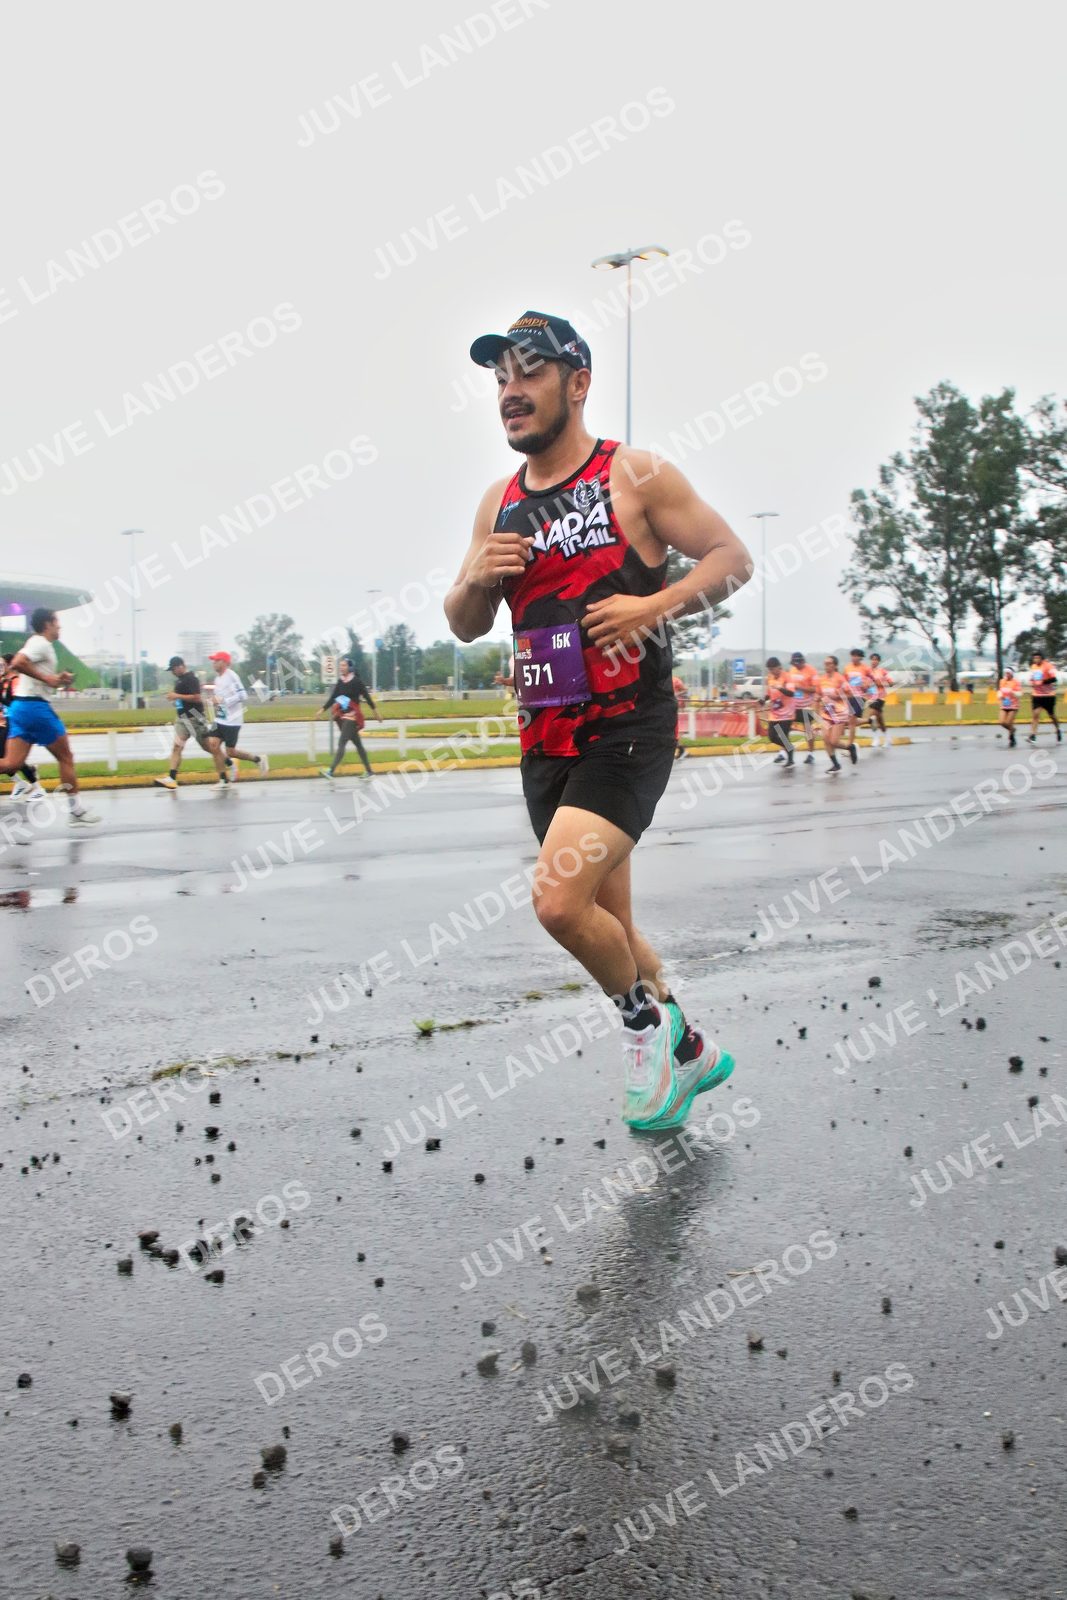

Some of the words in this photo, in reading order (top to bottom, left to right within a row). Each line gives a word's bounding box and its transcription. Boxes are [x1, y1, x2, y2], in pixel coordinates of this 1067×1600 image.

[559, 526, 617, 558] TRAIL
[551, 632, 571, 650] 15K
[522, 662, 554, 687] 571
